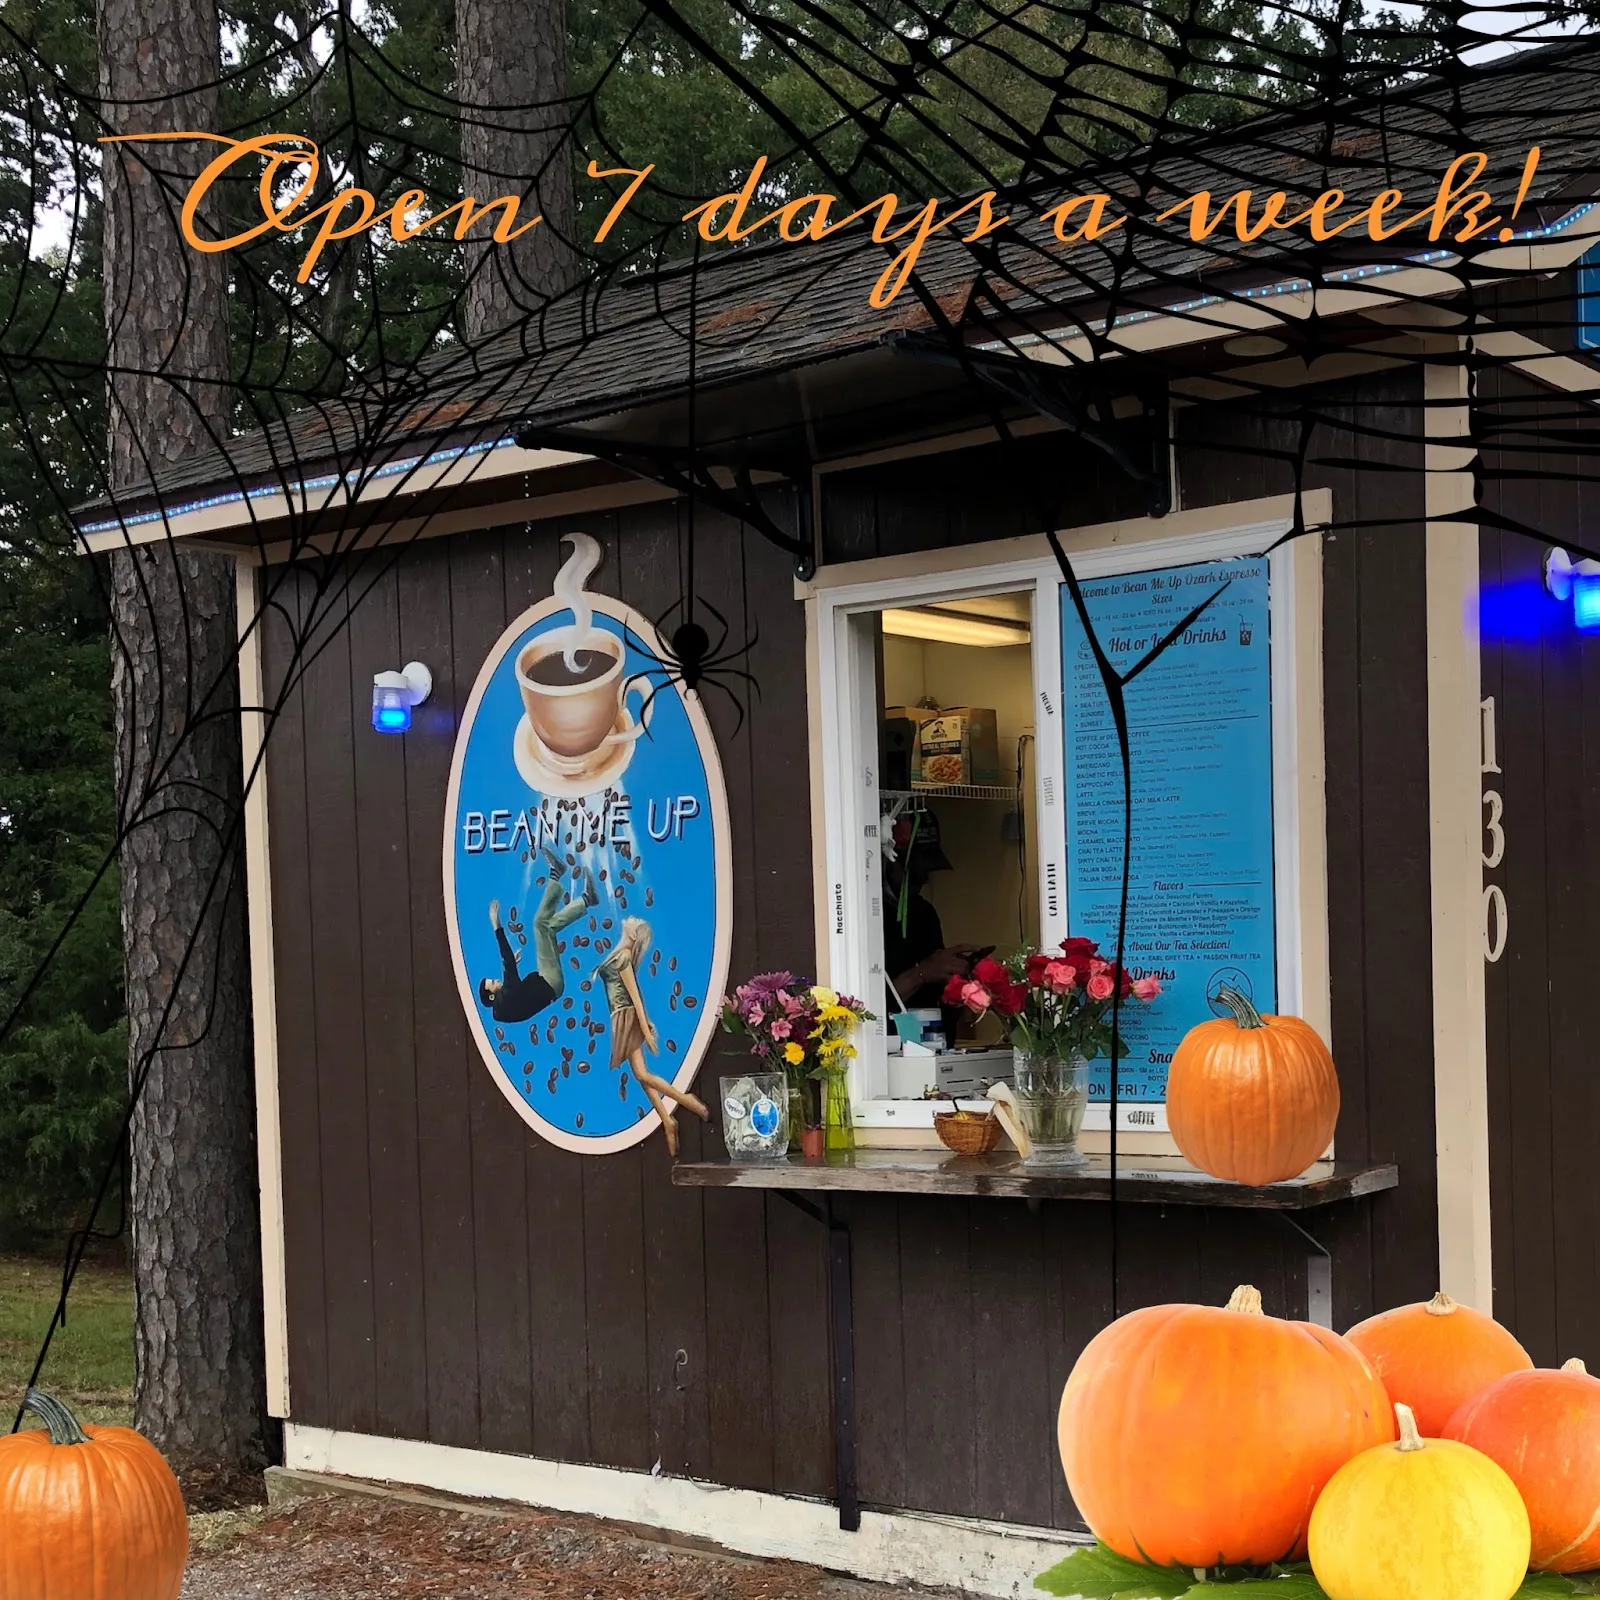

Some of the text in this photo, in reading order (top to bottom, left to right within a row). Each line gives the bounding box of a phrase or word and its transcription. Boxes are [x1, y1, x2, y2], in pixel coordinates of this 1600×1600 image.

[1066, 568, 1261, 600] lcome to Bean Me Up Ozark Espresso
[1152, 594, 1173, 605] Sizes
[1109, 637, 1131, 653] Hot
[1134, 639, 1148, 650] or
[1182, 628, 1226, 645] Drinks
[463, 795, 701, 854] BEAN ME UP
[1078, 837, 1105, 845] CARAMEL
[1153, 880, 1184, 891] Flavors
[1128, 941, 1153, 952] About
[1155, 940, 1171, 950] Our
[1173, 939, 1187, 950] Tea
[1190, 939, 1231, 950] Selection!
[1132, 966, 1176, 981] Drinks
[1148, 1048, 1174, 1065] Sna
[1088, 1084, 1106, 1095] ON
[1118, 1084, 1138, 1096] FRI
[1141, 1084, 1148, 1096] 7
[1127, 1110, 1156, 1126] COFFEE
